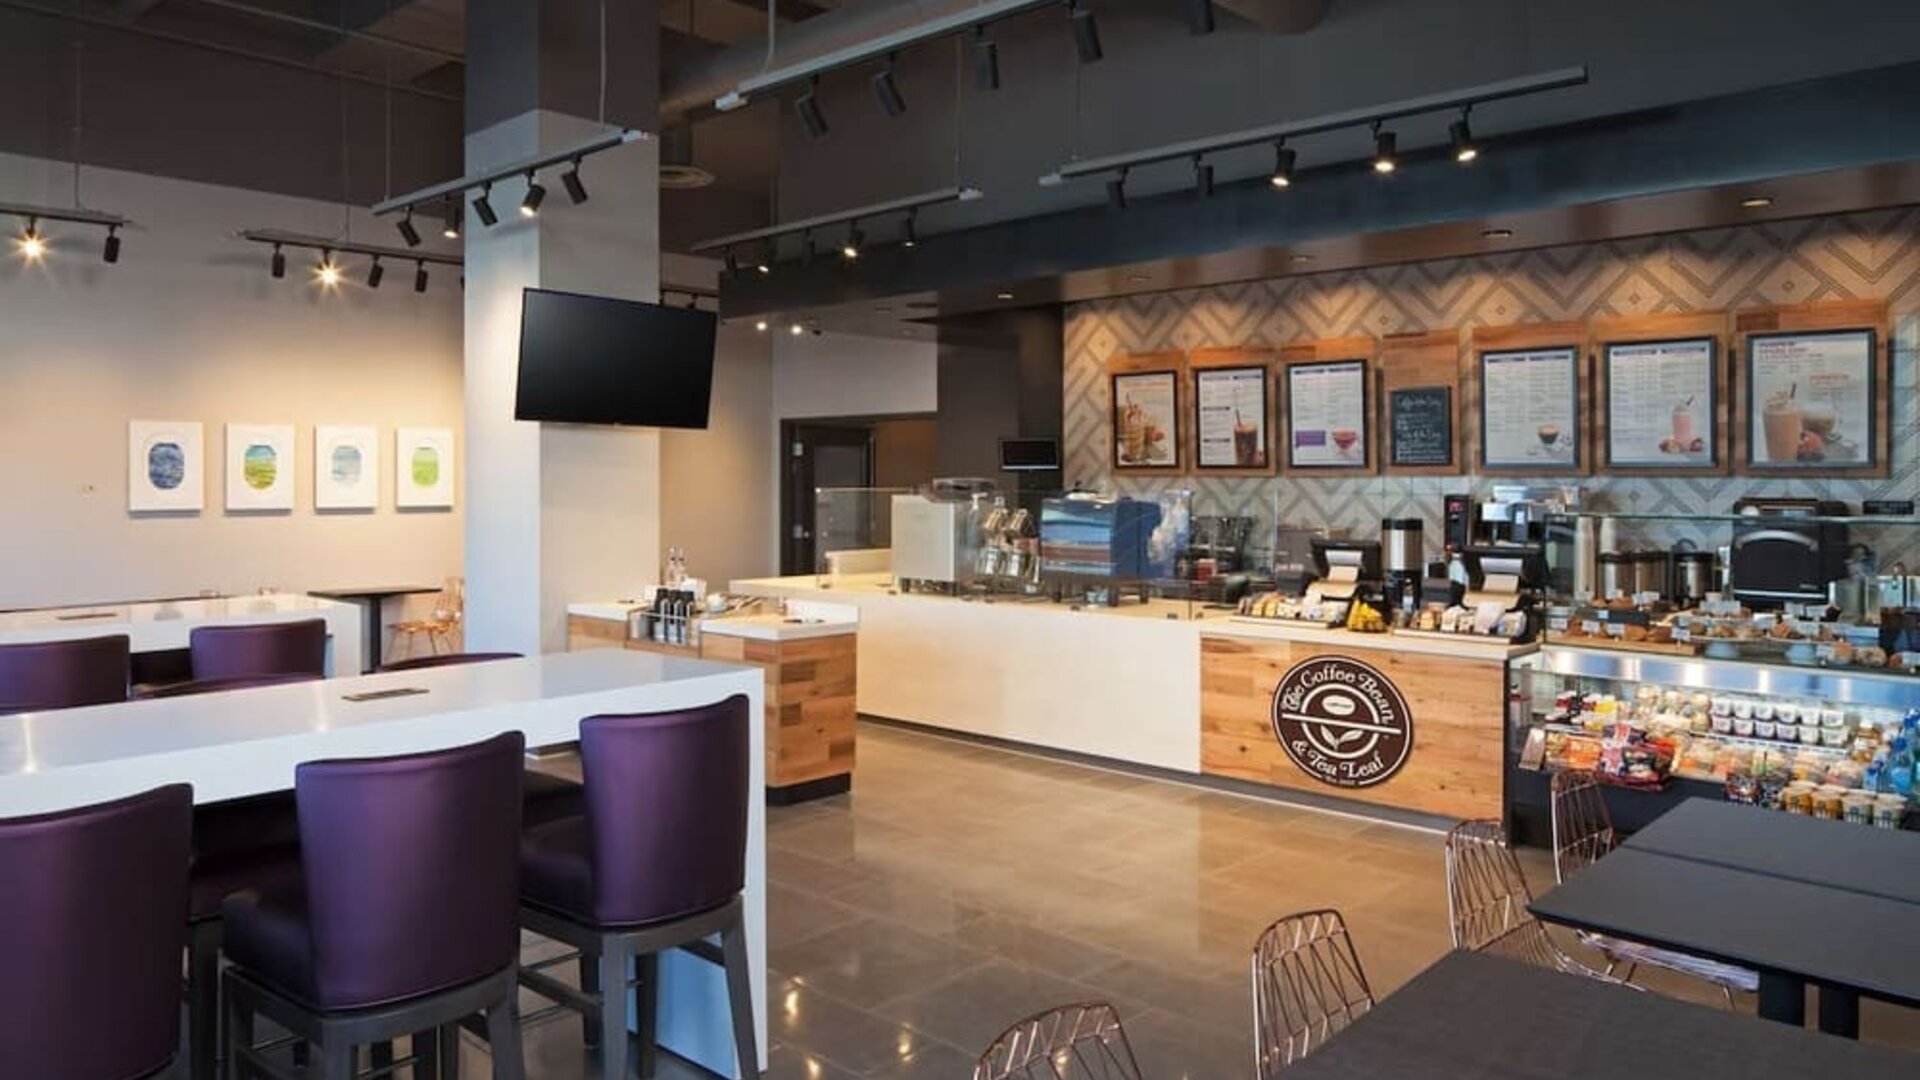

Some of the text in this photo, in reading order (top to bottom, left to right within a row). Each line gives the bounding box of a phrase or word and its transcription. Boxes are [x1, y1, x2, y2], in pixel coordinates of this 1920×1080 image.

[1282, 664, 1395, 724] The Coffee Bean
[1292, 740, 1384, 778] & Tea Leaf
